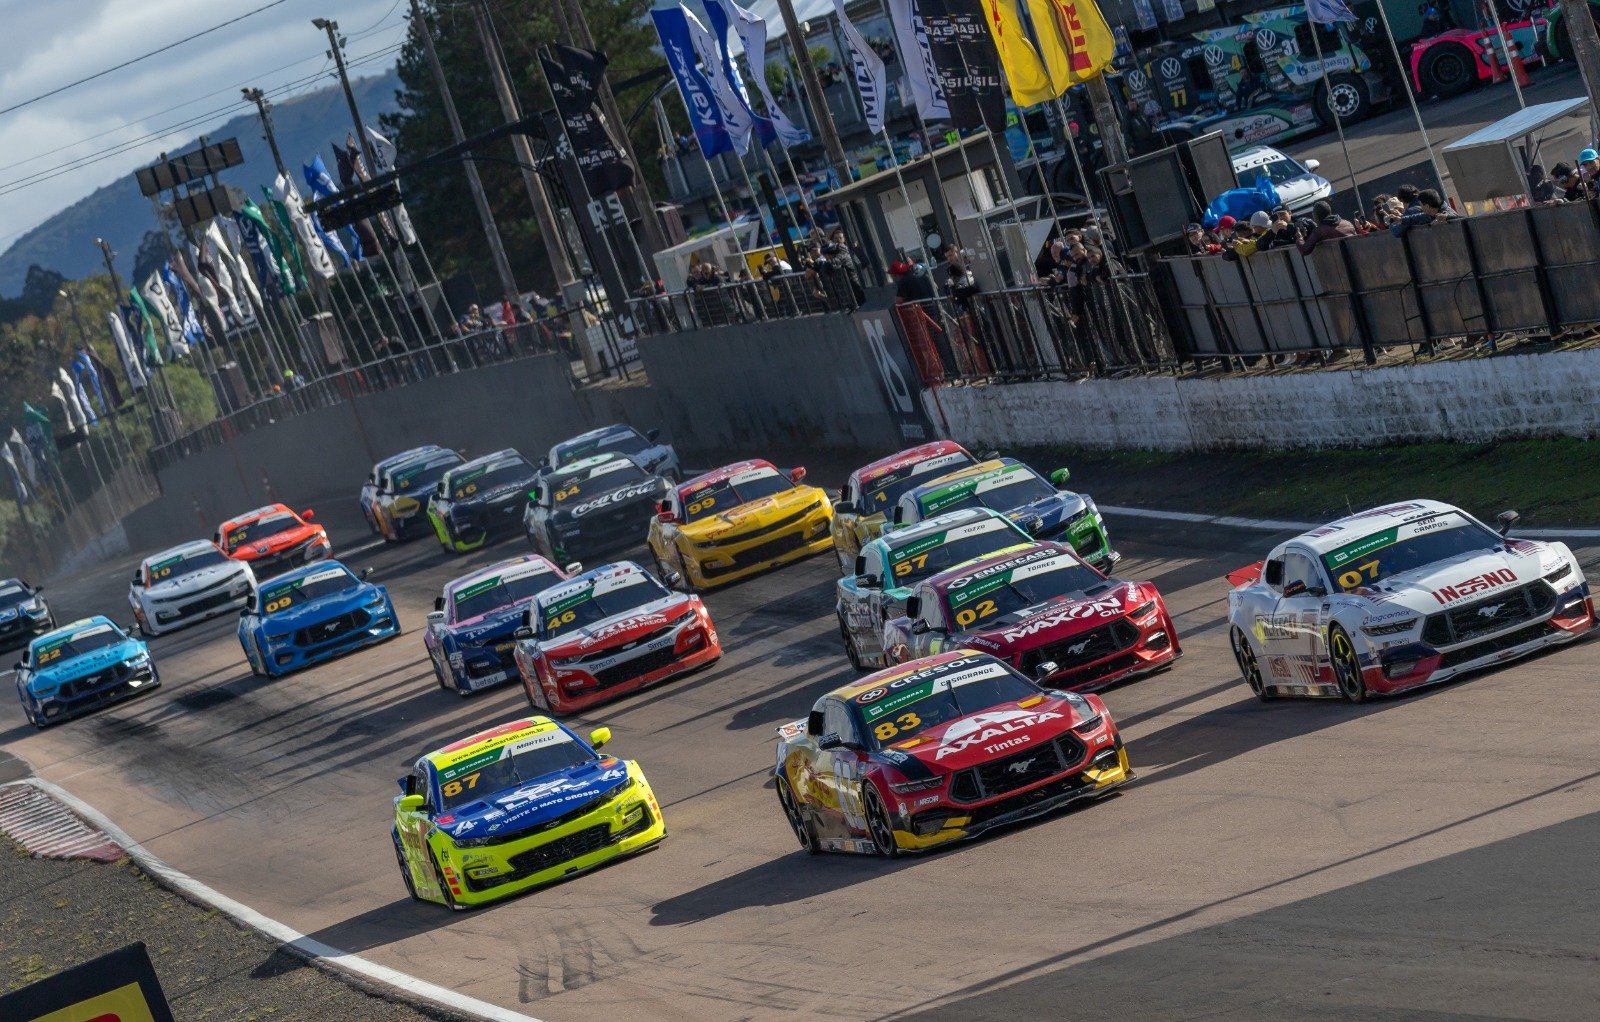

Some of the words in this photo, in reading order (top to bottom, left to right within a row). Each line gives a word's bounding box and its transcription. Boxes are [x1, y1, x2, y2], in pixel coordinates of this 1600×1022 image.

[1282, 38, 1300, 56] 31
[1253, 154, 1280, 165] CAR
[992, 475, 1015, 485] BUENO
[688, 496, 716, 515] 99
[1413, 520, 1449, 534] CAMPOS
[1349, 536, 1389, 555] PETROBRAS
[895, 553, 929, 577] 57
[1027, 560, 1056, 572] TORRES
[1338, 559, 1381, 589] 07
[265, 597, 292, 613] 09
[955, 599, 998, 625] 02
[1100, 608, 1125, 618] OIL
[547, 610, 577, 631] 46
[1003, 597, 1121, 644] MAXON
[890, 657, 980, 689] CRESOL
[884, 689, 924, 708] PETROBRAS
[874, 712, 922, 740] 83
[516, 735, 555, 750] MARTELLI
[935, 711, 1065, 761] AXALTA
[984, 734, 1031, 754] Tintas
[443, 772, 482, 797] 87
[503, 807, 531, 825] VISITE
[538, 796, 564, 809] MATO
[564, 789, 601, 802] GROSSO
